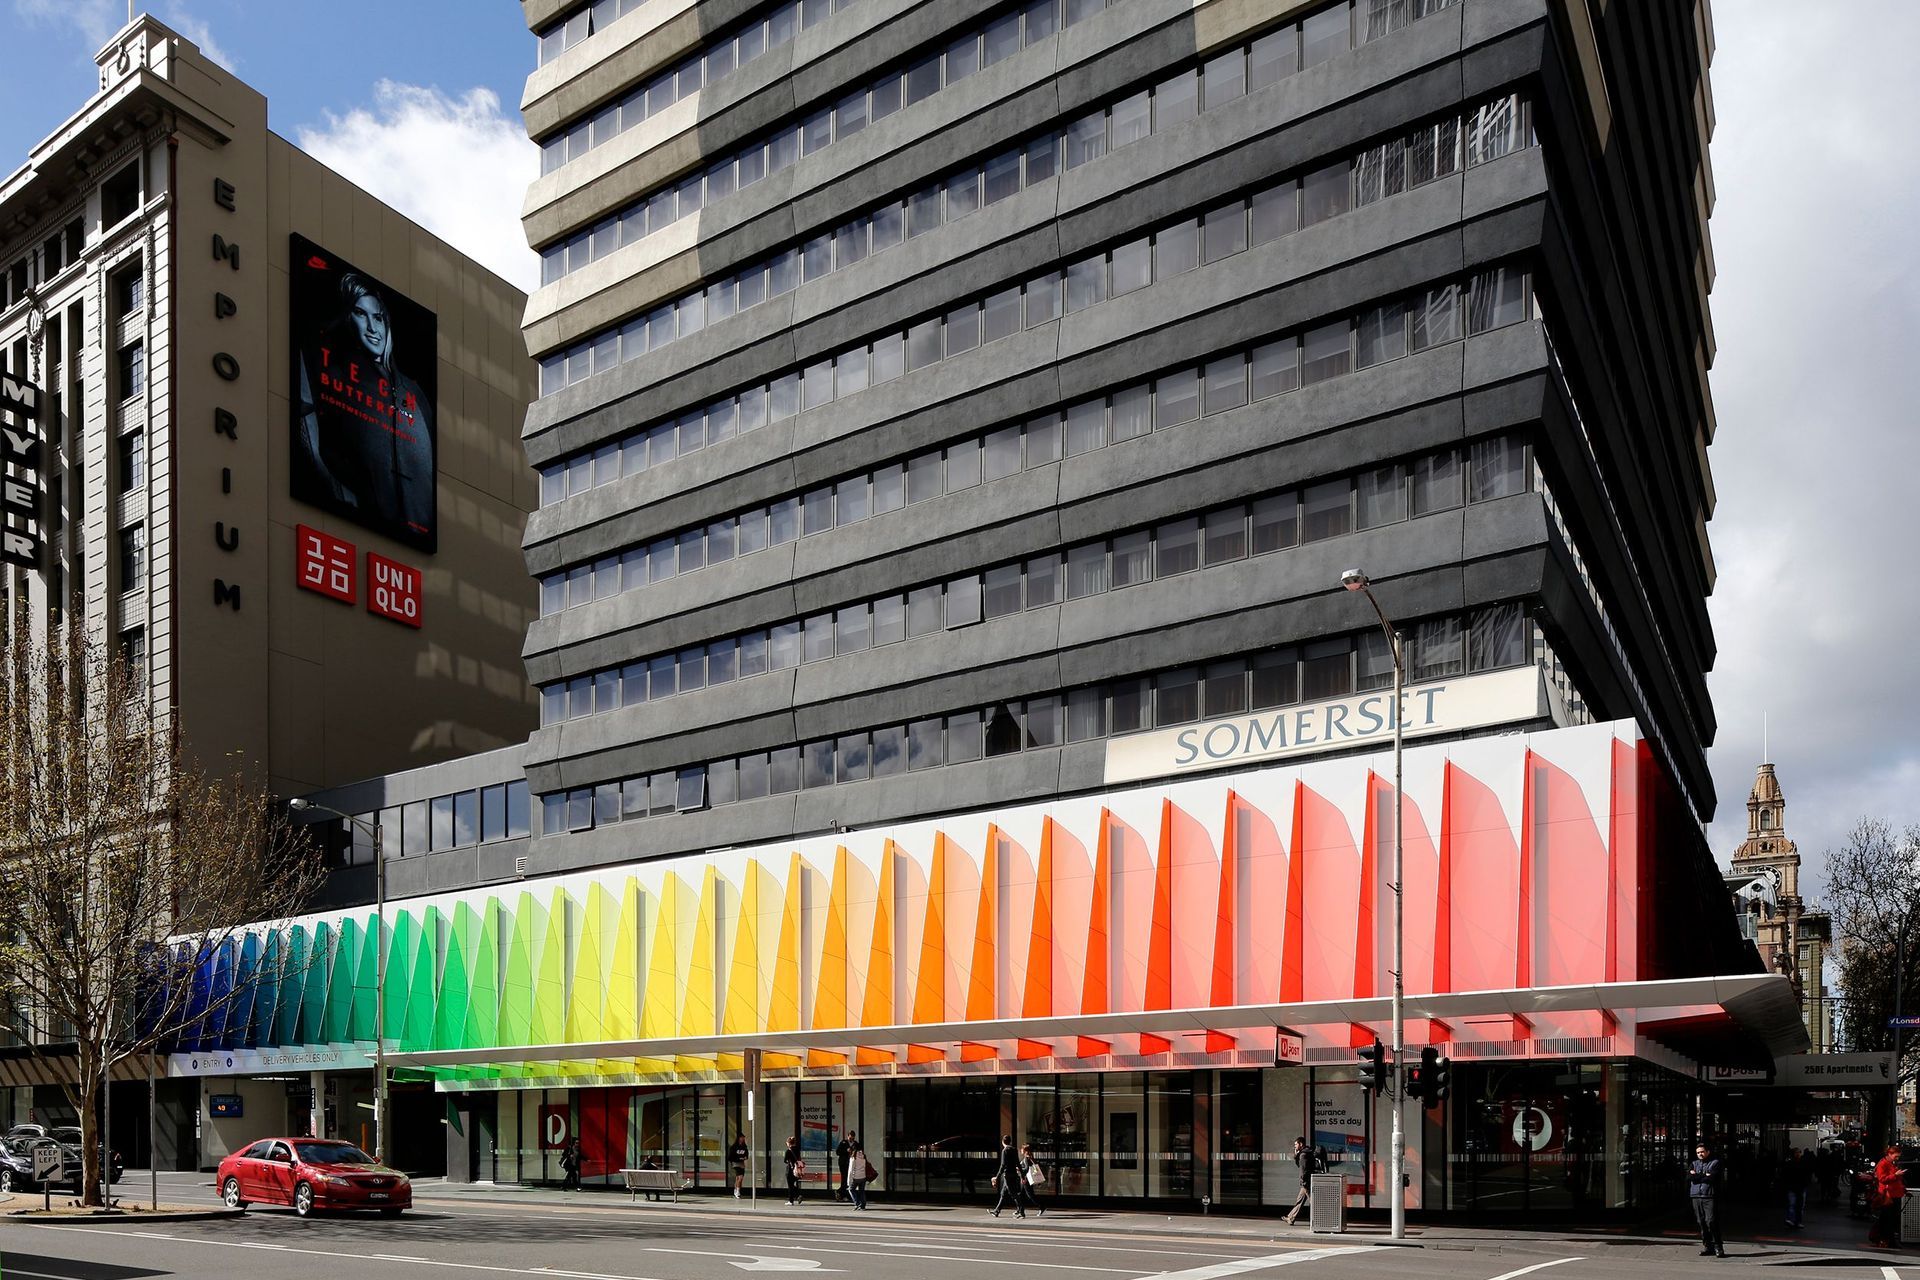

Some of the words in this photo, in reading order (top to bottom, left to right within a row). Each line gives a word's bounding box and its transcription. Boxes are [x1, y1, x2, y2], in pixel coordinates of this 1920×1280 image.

[321, 347, 417, 412] TECH
[212, 177, 241, 611] EMPORIUM
[2, 376, 36, 560] MYER
[375, 561, 413, 594] UNI
[375, 587, 417, 618] QLO
[1174, 686, 1446, 765] SOMERSET
[263, 1055, 290, 1065] DELIVERY
[292, 1053, 320, 1064] VEHICLES
[322, 1051, 338, 1062] ONLY
[1288, 1046, 1300, 1056] POST
[203, 1059, 221, 1069] ENTRY
[1804, 1065, 1825, 1075] 250E
[1827, 1063, 1874, 1075] Apartments
[1314, 1099, 1333, 1107] ravel
[1328, 1117, 1338, 1125] $5
[1346, 1118, 1362, 1126] day
